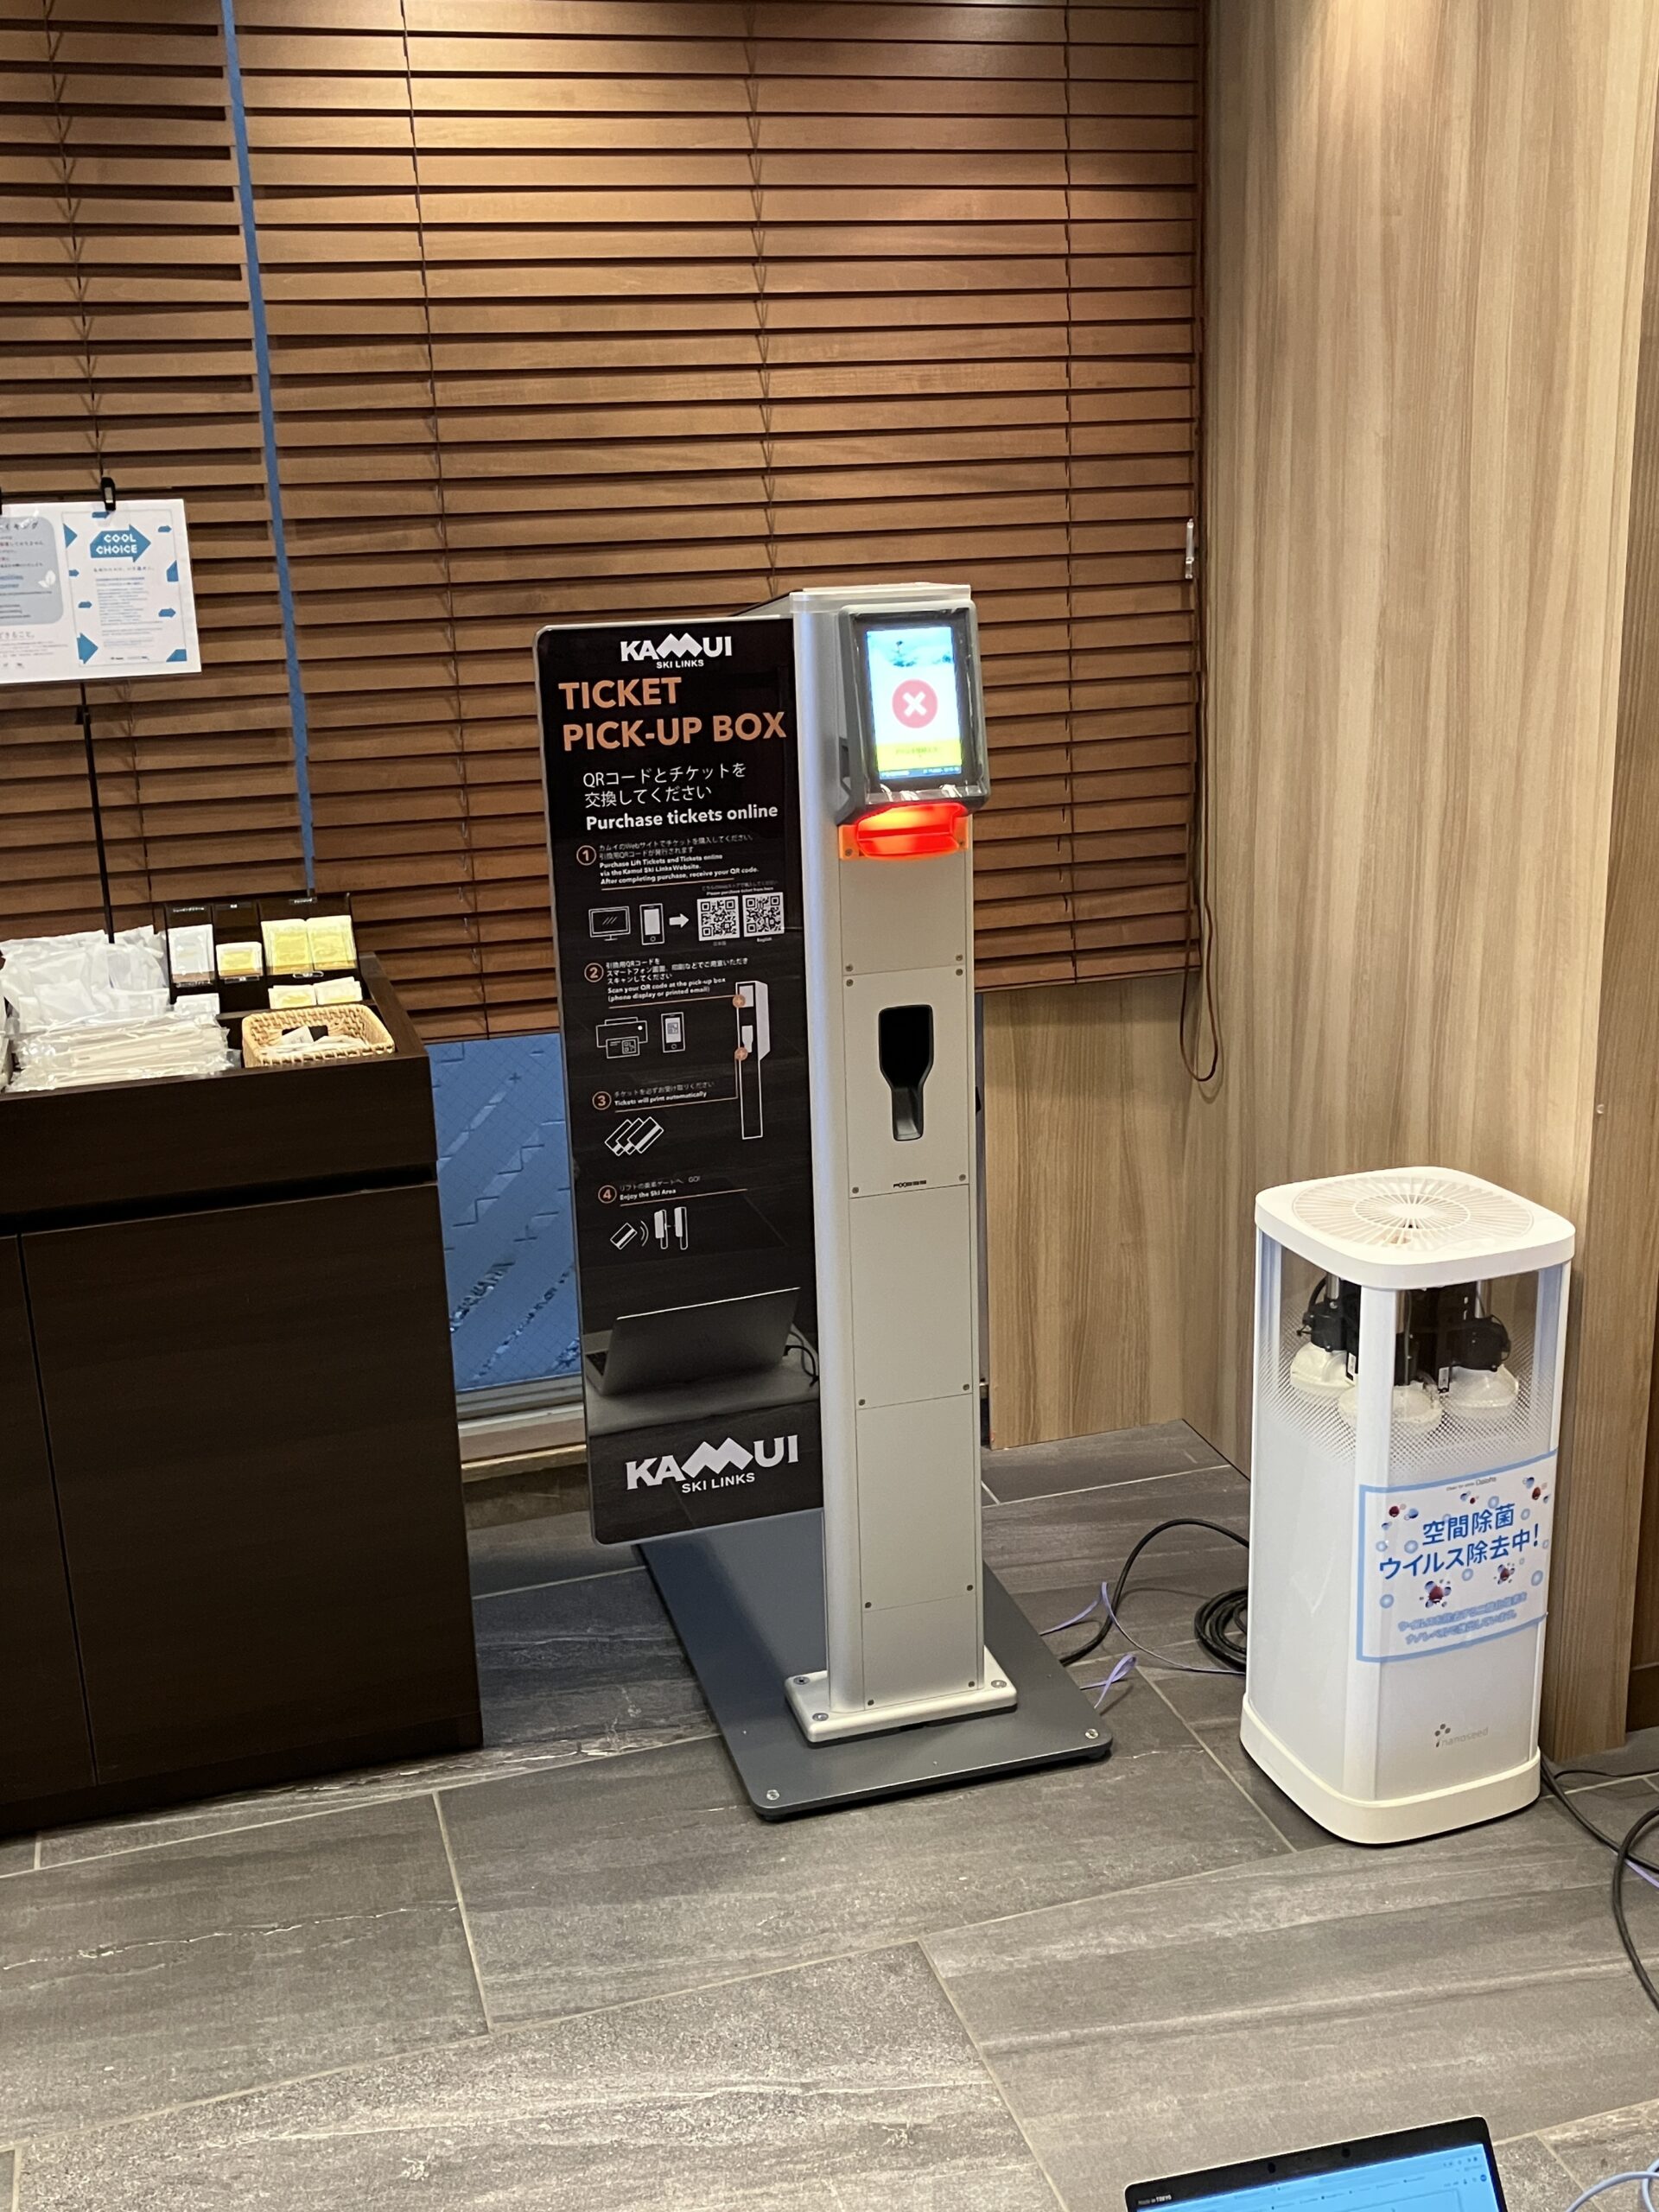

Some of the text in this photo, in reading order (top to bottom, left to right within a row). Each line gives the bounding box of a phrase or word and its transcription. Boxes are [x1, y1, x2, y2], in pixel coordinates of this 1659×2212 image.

[96, 544, 137, 554] CHOICE
[104, 533, 137, 543] COOL
[620, 632, 733, 662] KAMUI
[675, 659, 704, 668] LINKS
[558, 677, 682, 710] TICKET
[563, 711, 787, 752] PICK-UP BOX
[582, 762, 747, 788] QRコードとチケットを
[585, 785, 712, 809] 交換してください
[586, 804, 779, 830] Purchase tickets online
[600, 860, 630, 868] Purchase
[665, 988, 689, 997] printed
[665, 1090, 708, 1100] automatically
[625, 1434, 799, 1491] KAMUI
[681, 1472, 755, 1493] SKI LINKS
[1422, 1503, 1515, 1546] 空間除菌
